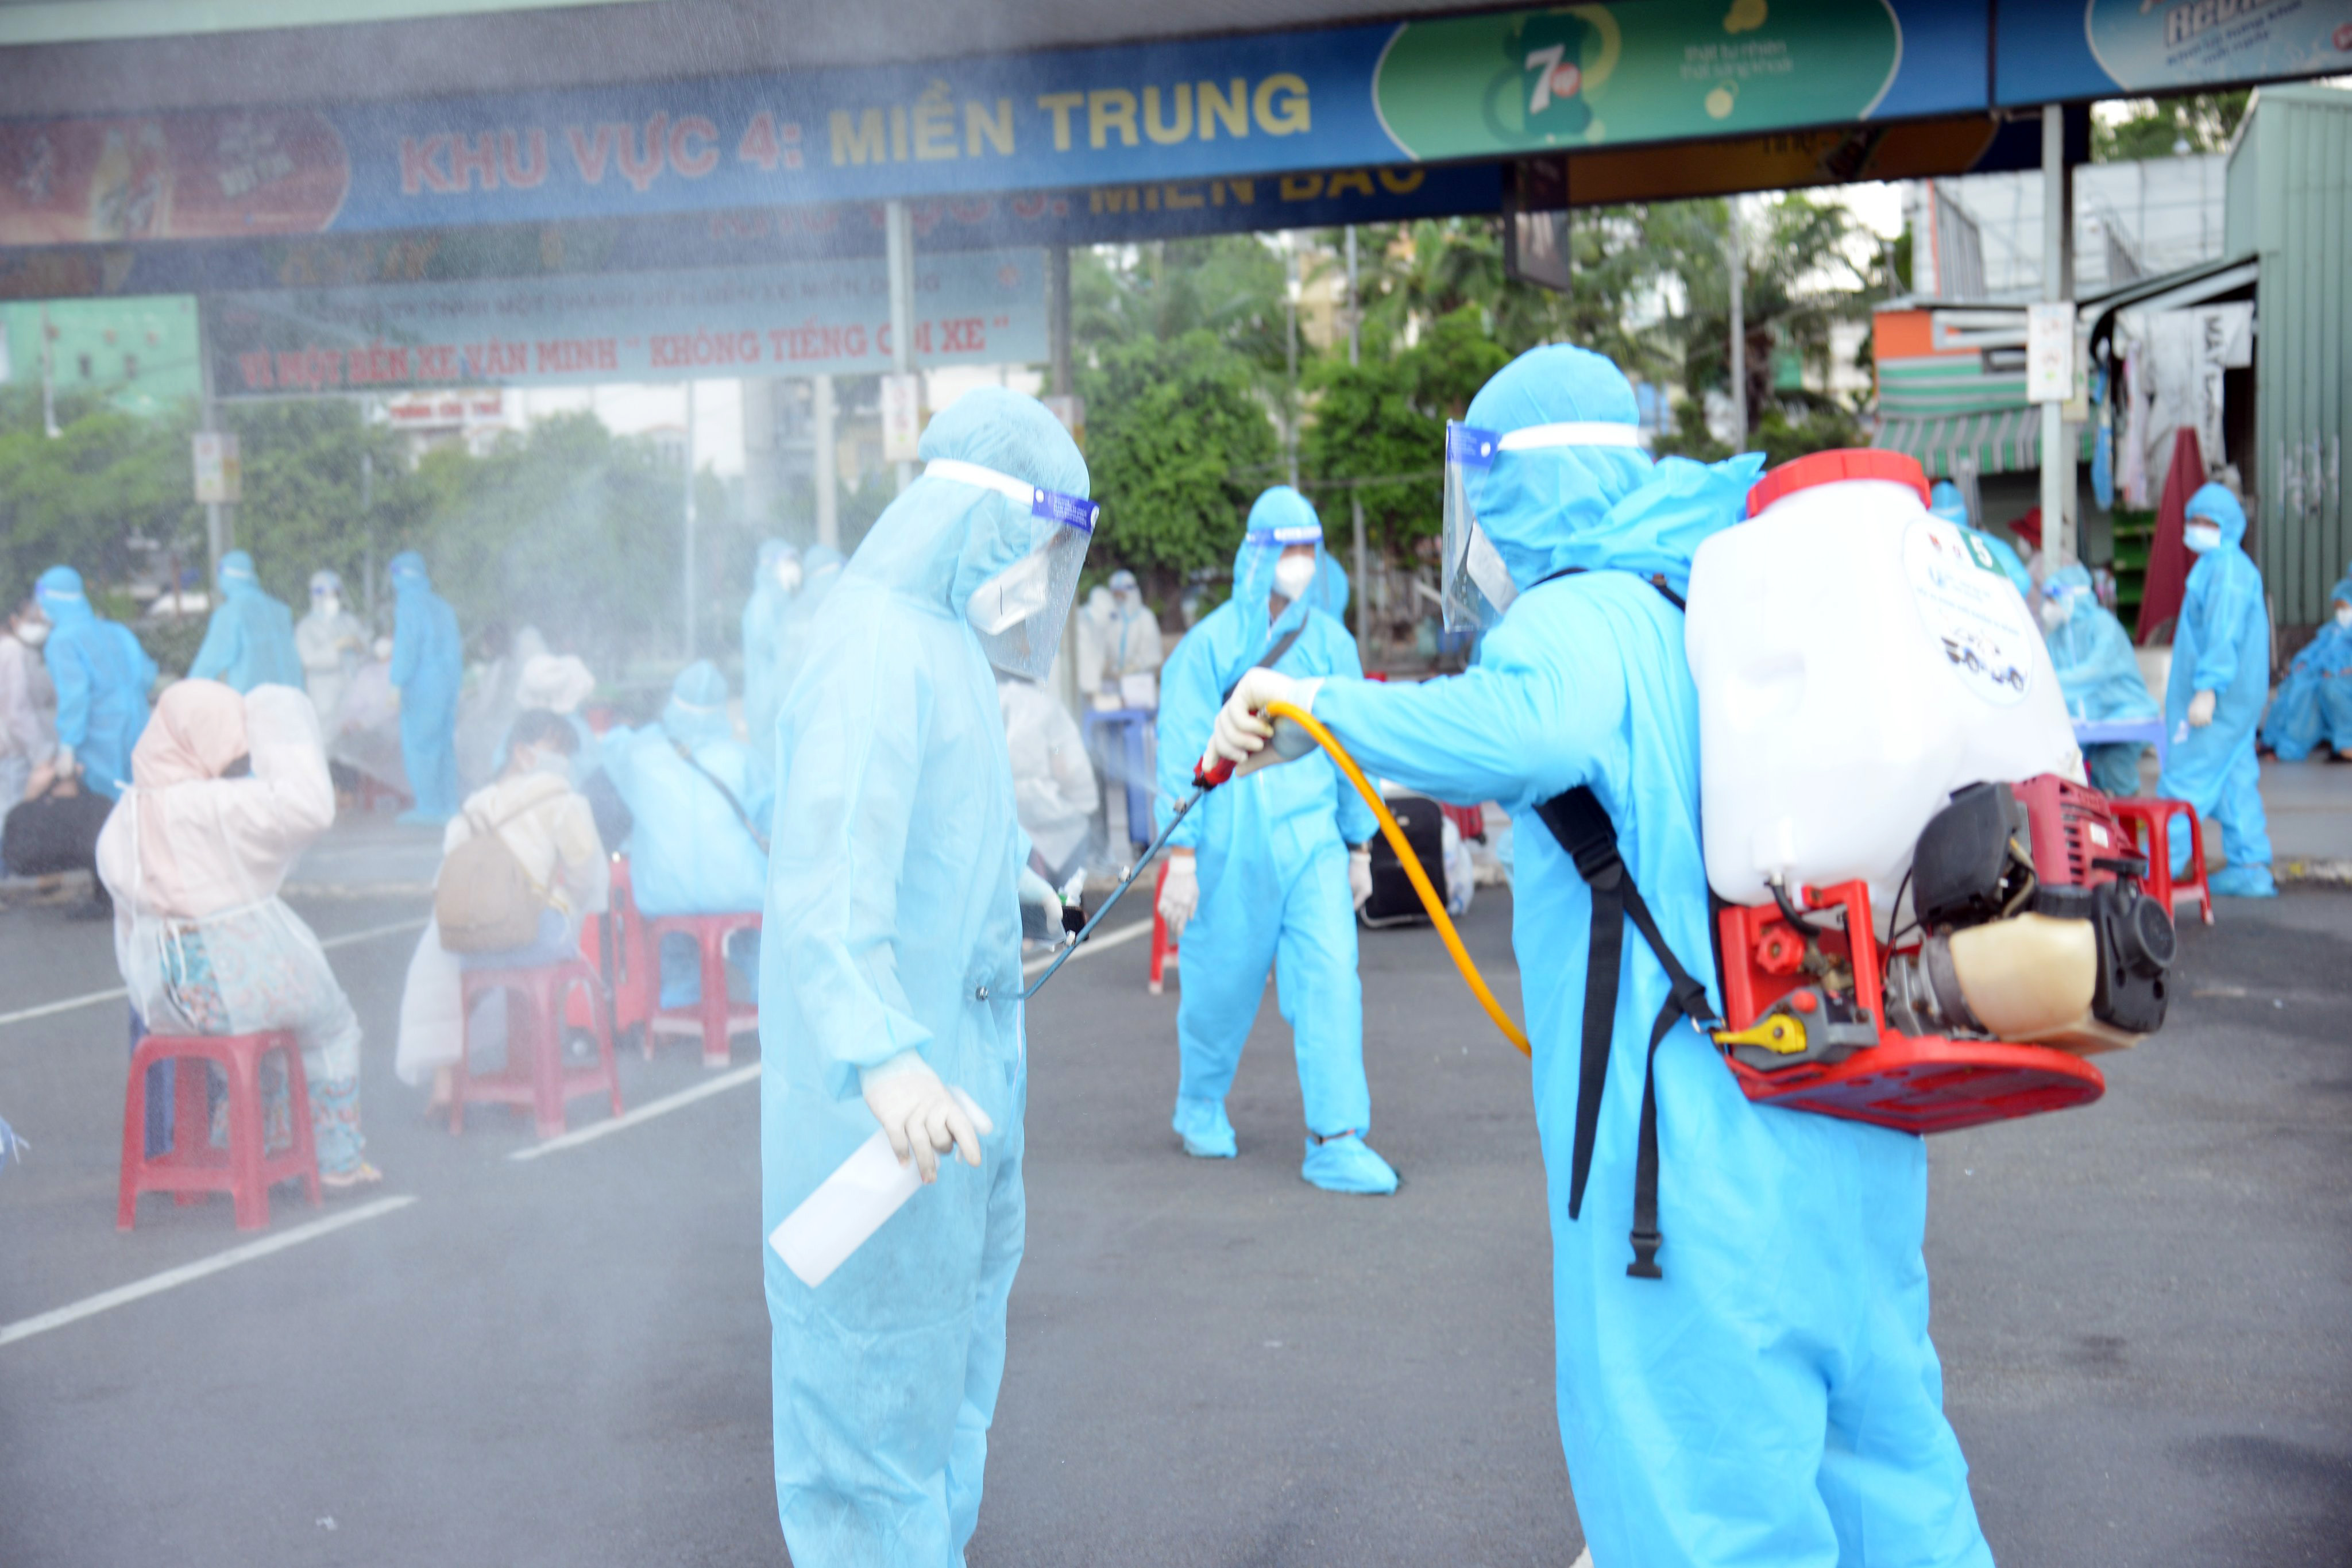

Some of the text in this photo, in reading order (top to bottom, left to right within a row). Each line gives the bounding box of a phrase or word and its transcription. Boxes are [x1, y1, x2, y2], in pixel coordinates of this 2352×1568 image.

[400, 72, 1312, 195] KHU VỰC 4: MIỀN TRUNG
[416, 345, 458, 380] XE
[536, 338, 619, 373] MINH
[768, 315, 868, 362] TIẾNG
[941, 317, 986, 353] XE
